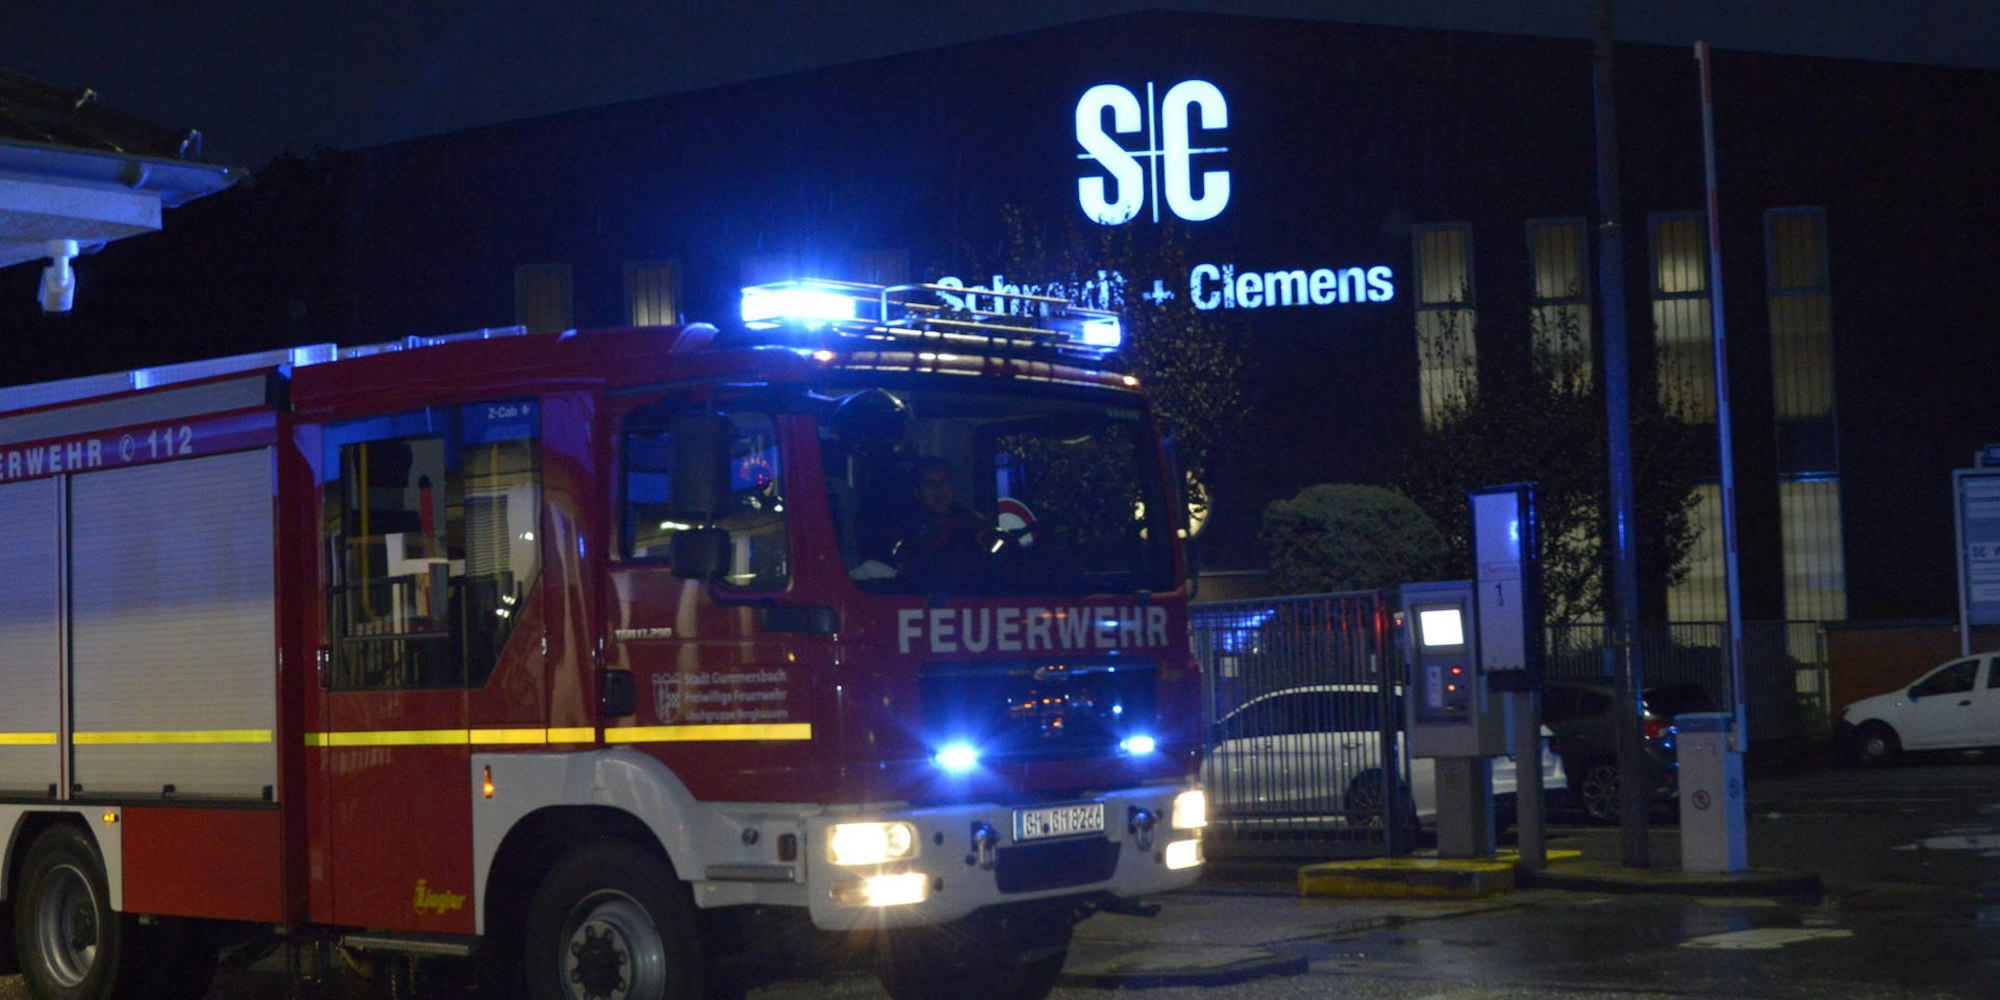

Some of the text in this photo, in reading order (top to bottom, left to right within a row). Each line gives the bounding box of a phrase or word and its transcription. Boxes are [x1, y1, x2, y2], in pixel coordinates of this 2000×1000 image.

[1189, 263, 1395, 311] Clemens
[148, 425, 193, 459] 112
[898, 605, 1169, 654] FEUERWEHR
